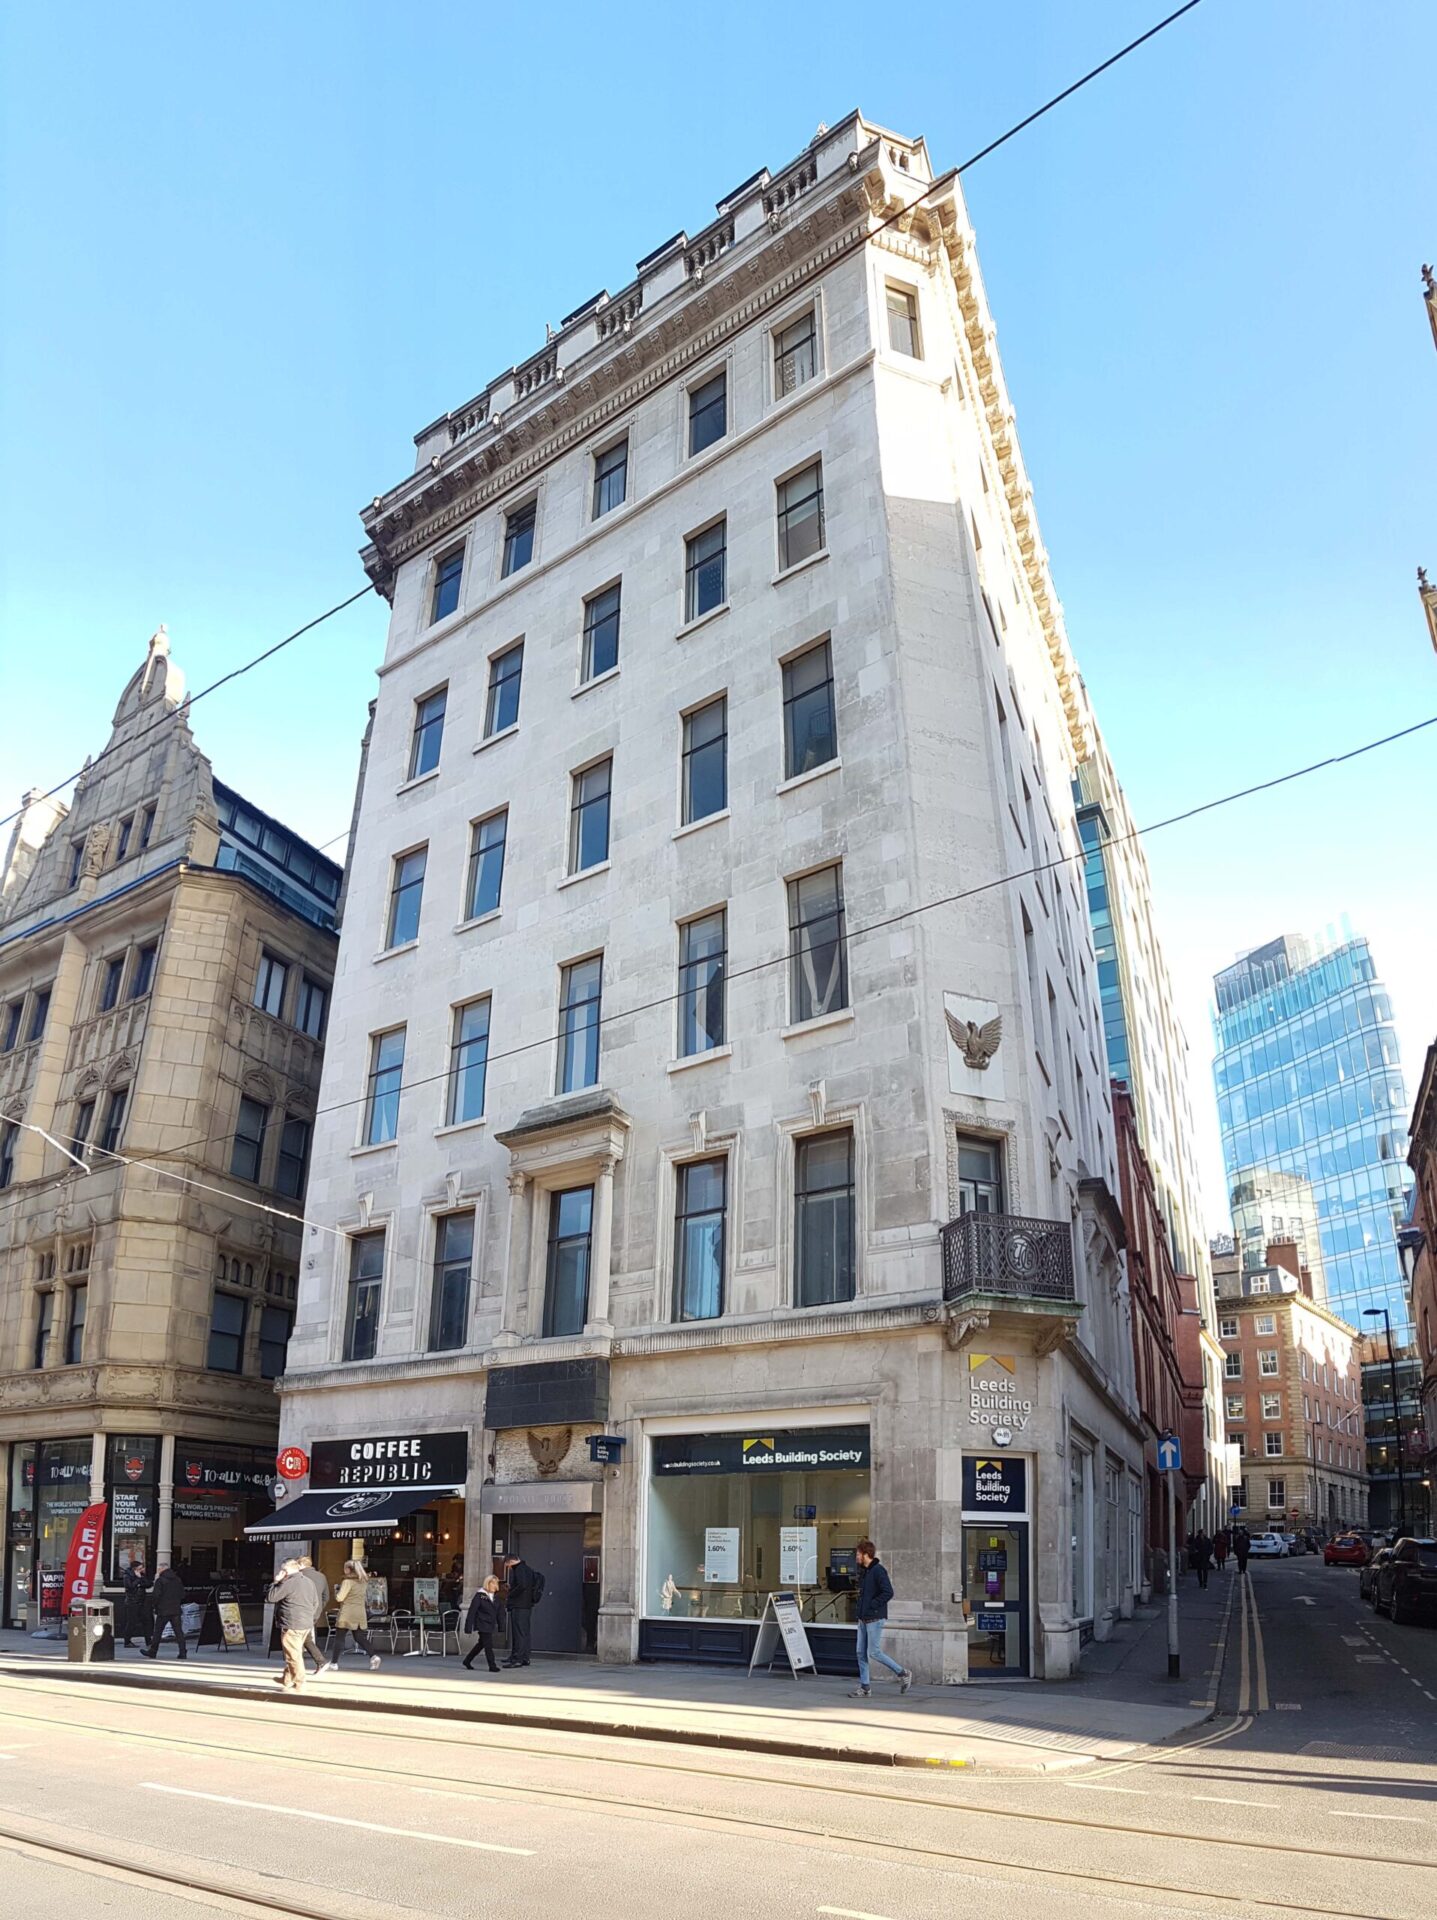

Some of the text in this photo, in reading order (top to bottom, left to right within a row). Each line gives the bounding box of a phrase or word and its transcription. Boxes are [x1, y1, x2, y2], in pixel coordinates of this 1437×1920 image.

[970, 1376, 1016, 1392] Leeds
[970, 1394, 1031, 1414] Building
[970, 1410, 1028, 1430] Society
[351, 1440, 421, 1460] COFFEE
[743, 1450, 862, 1465] Leeds Building Society
[339, 1462, 432, 1483] REPUBLIC
[976, 1471, 1002, 1479] Leeds
[976, 1480, 1010, 1494] Building
[976, 1492, 1008, 1503] Society
[186, 1503, 213, 1511] WORLD'S
[249, 1533, 301, 1542] COFFEE REPUBLIC
[332, 1529, 391, 1538] COFFEE REPUBLIC
[42, 1574, 65, 1582] VAPIN
